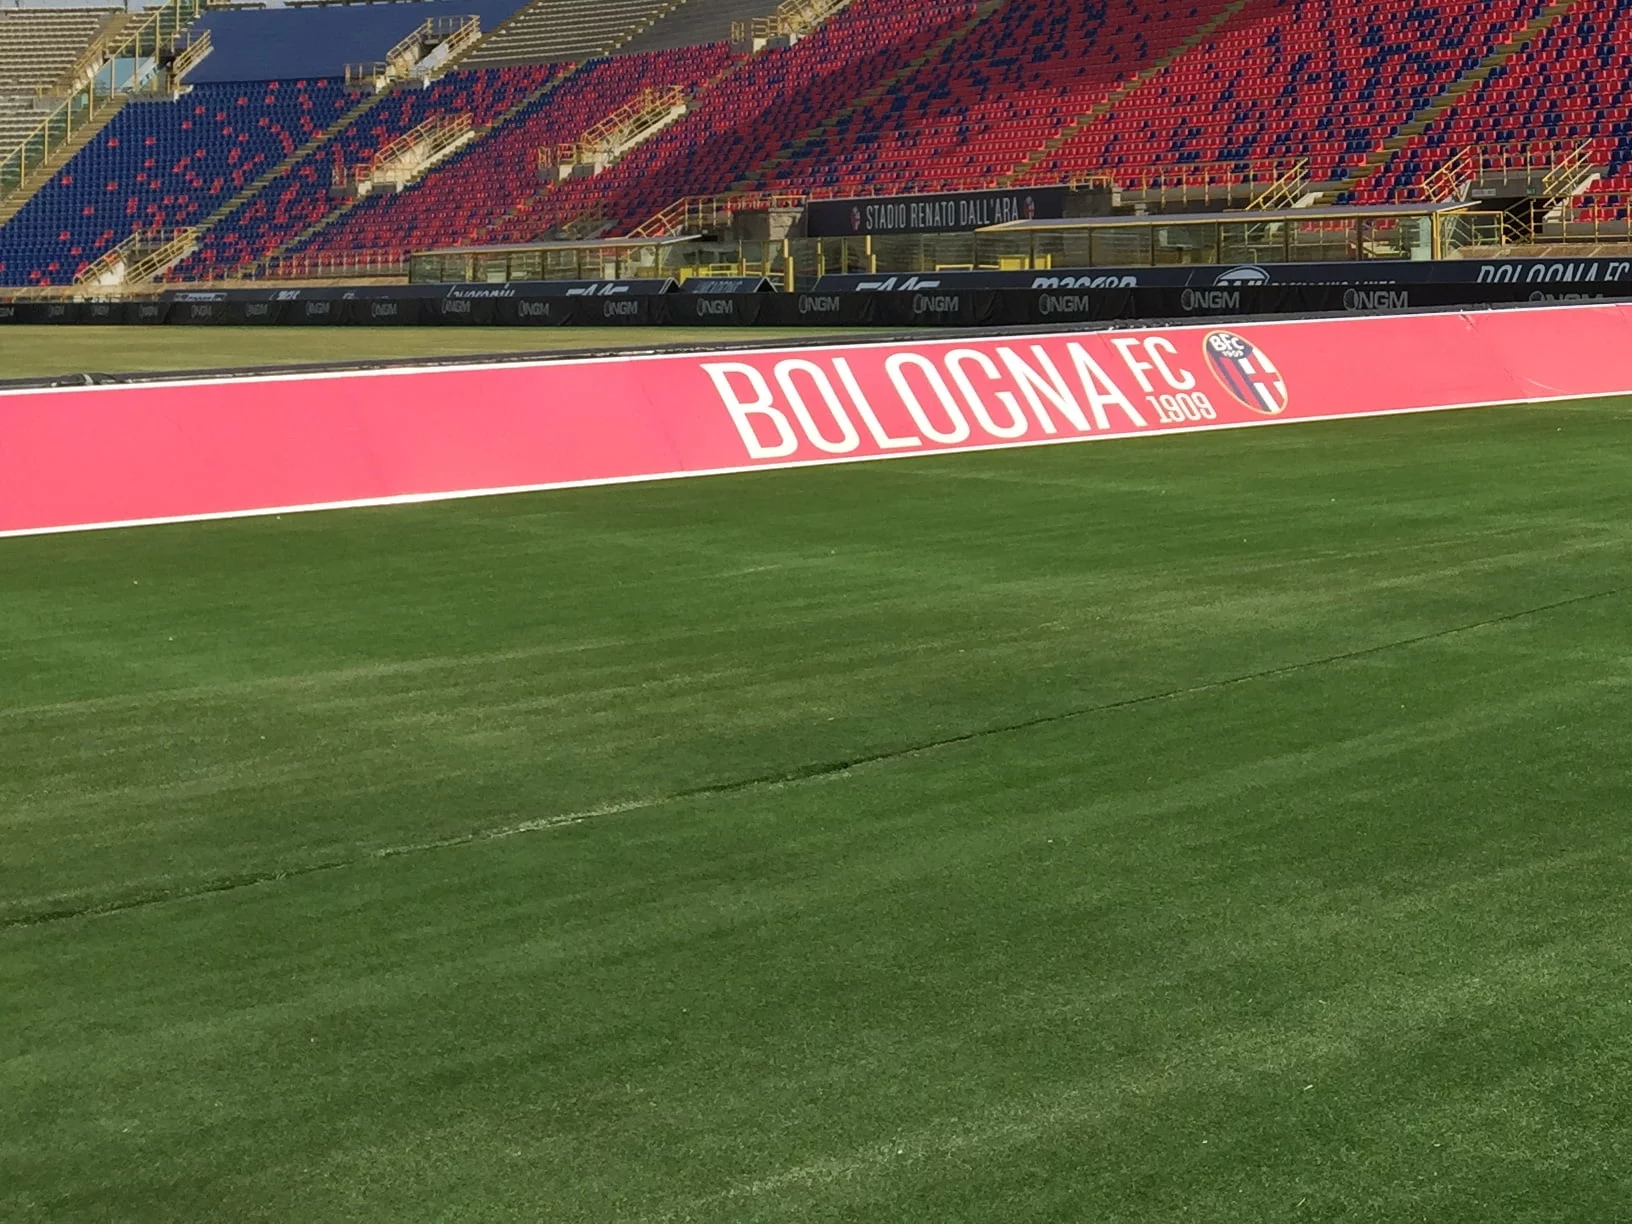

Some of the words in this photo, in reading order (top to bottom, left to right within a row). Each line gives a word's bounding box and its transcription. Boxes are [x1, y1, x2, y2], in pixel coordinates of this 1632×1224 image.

[866, 204, 906, 230] STADIO
[911, 201, 954, 228] RENATO
[1209, 333, 1244, 352] BFC
[700, 341, 1148, 460] BOLOGNA
[1111, 336, 1196, 393] FC
[1145, 391, 1218, 424] 1909
